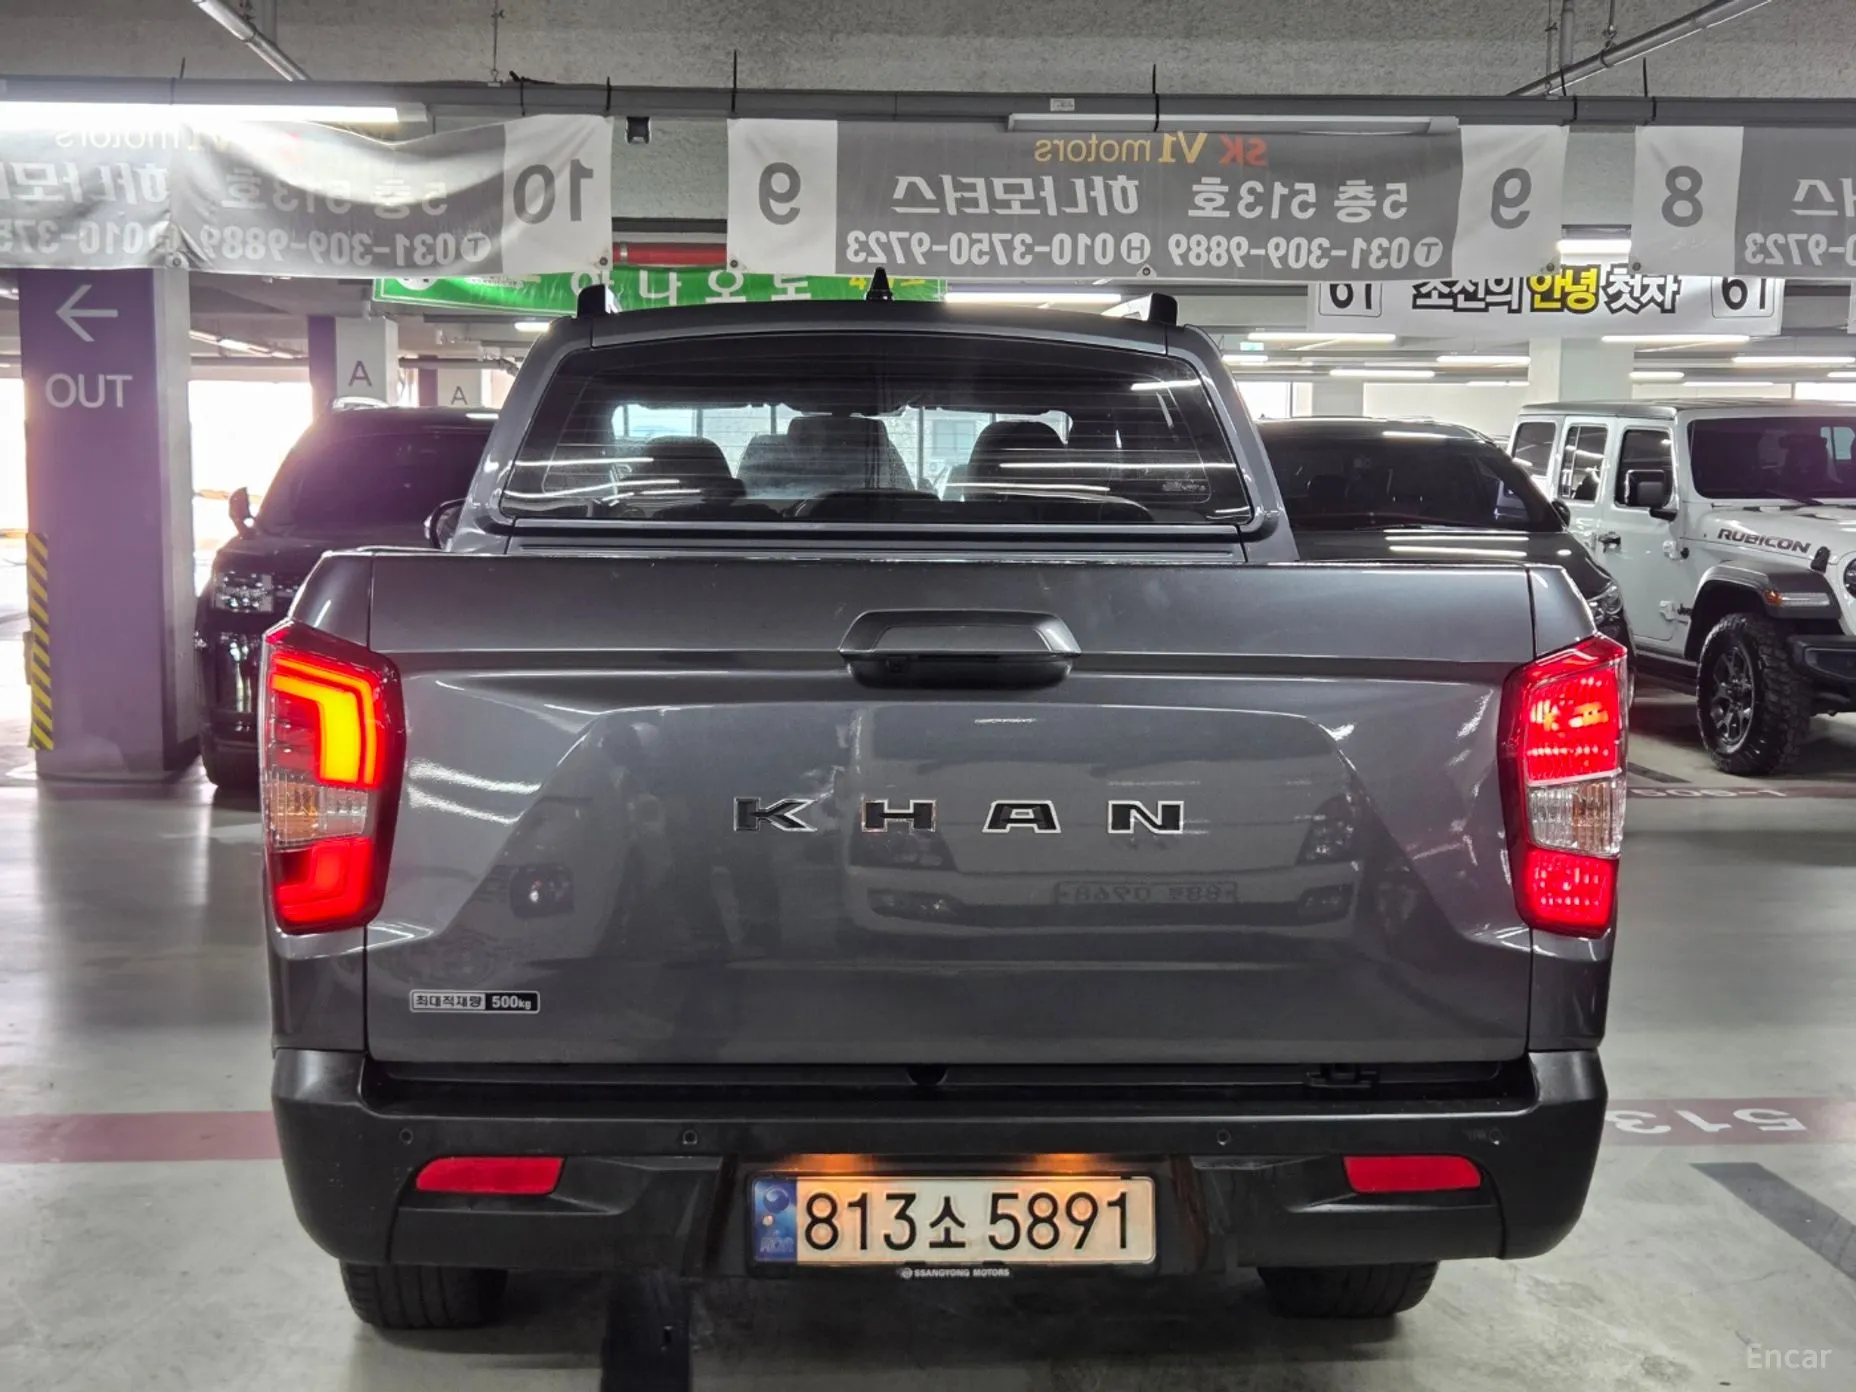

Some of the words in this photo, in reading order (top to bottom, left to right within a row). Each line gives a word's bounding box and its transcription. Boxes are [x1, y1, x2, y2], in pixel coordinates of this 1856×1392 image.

[348, 360, 373, 387] A
[45, 373, 133, 409] OUT
[450, 386, 468, 405] A
[1717, 528, 1812, 553] RUBICON
[734, 797, 1185, 834] KHAN
[415, 994, 482, 1008] 최대적재량
[491, 995, 532, 1010] 500kg
[1604, 1108, 1808, 1134] 513
[804, 1191, 966, 1250] 813소
[987, 1191, 1129, 1250] 5891
[973, 1268, 1010, 1277] MOTORS
